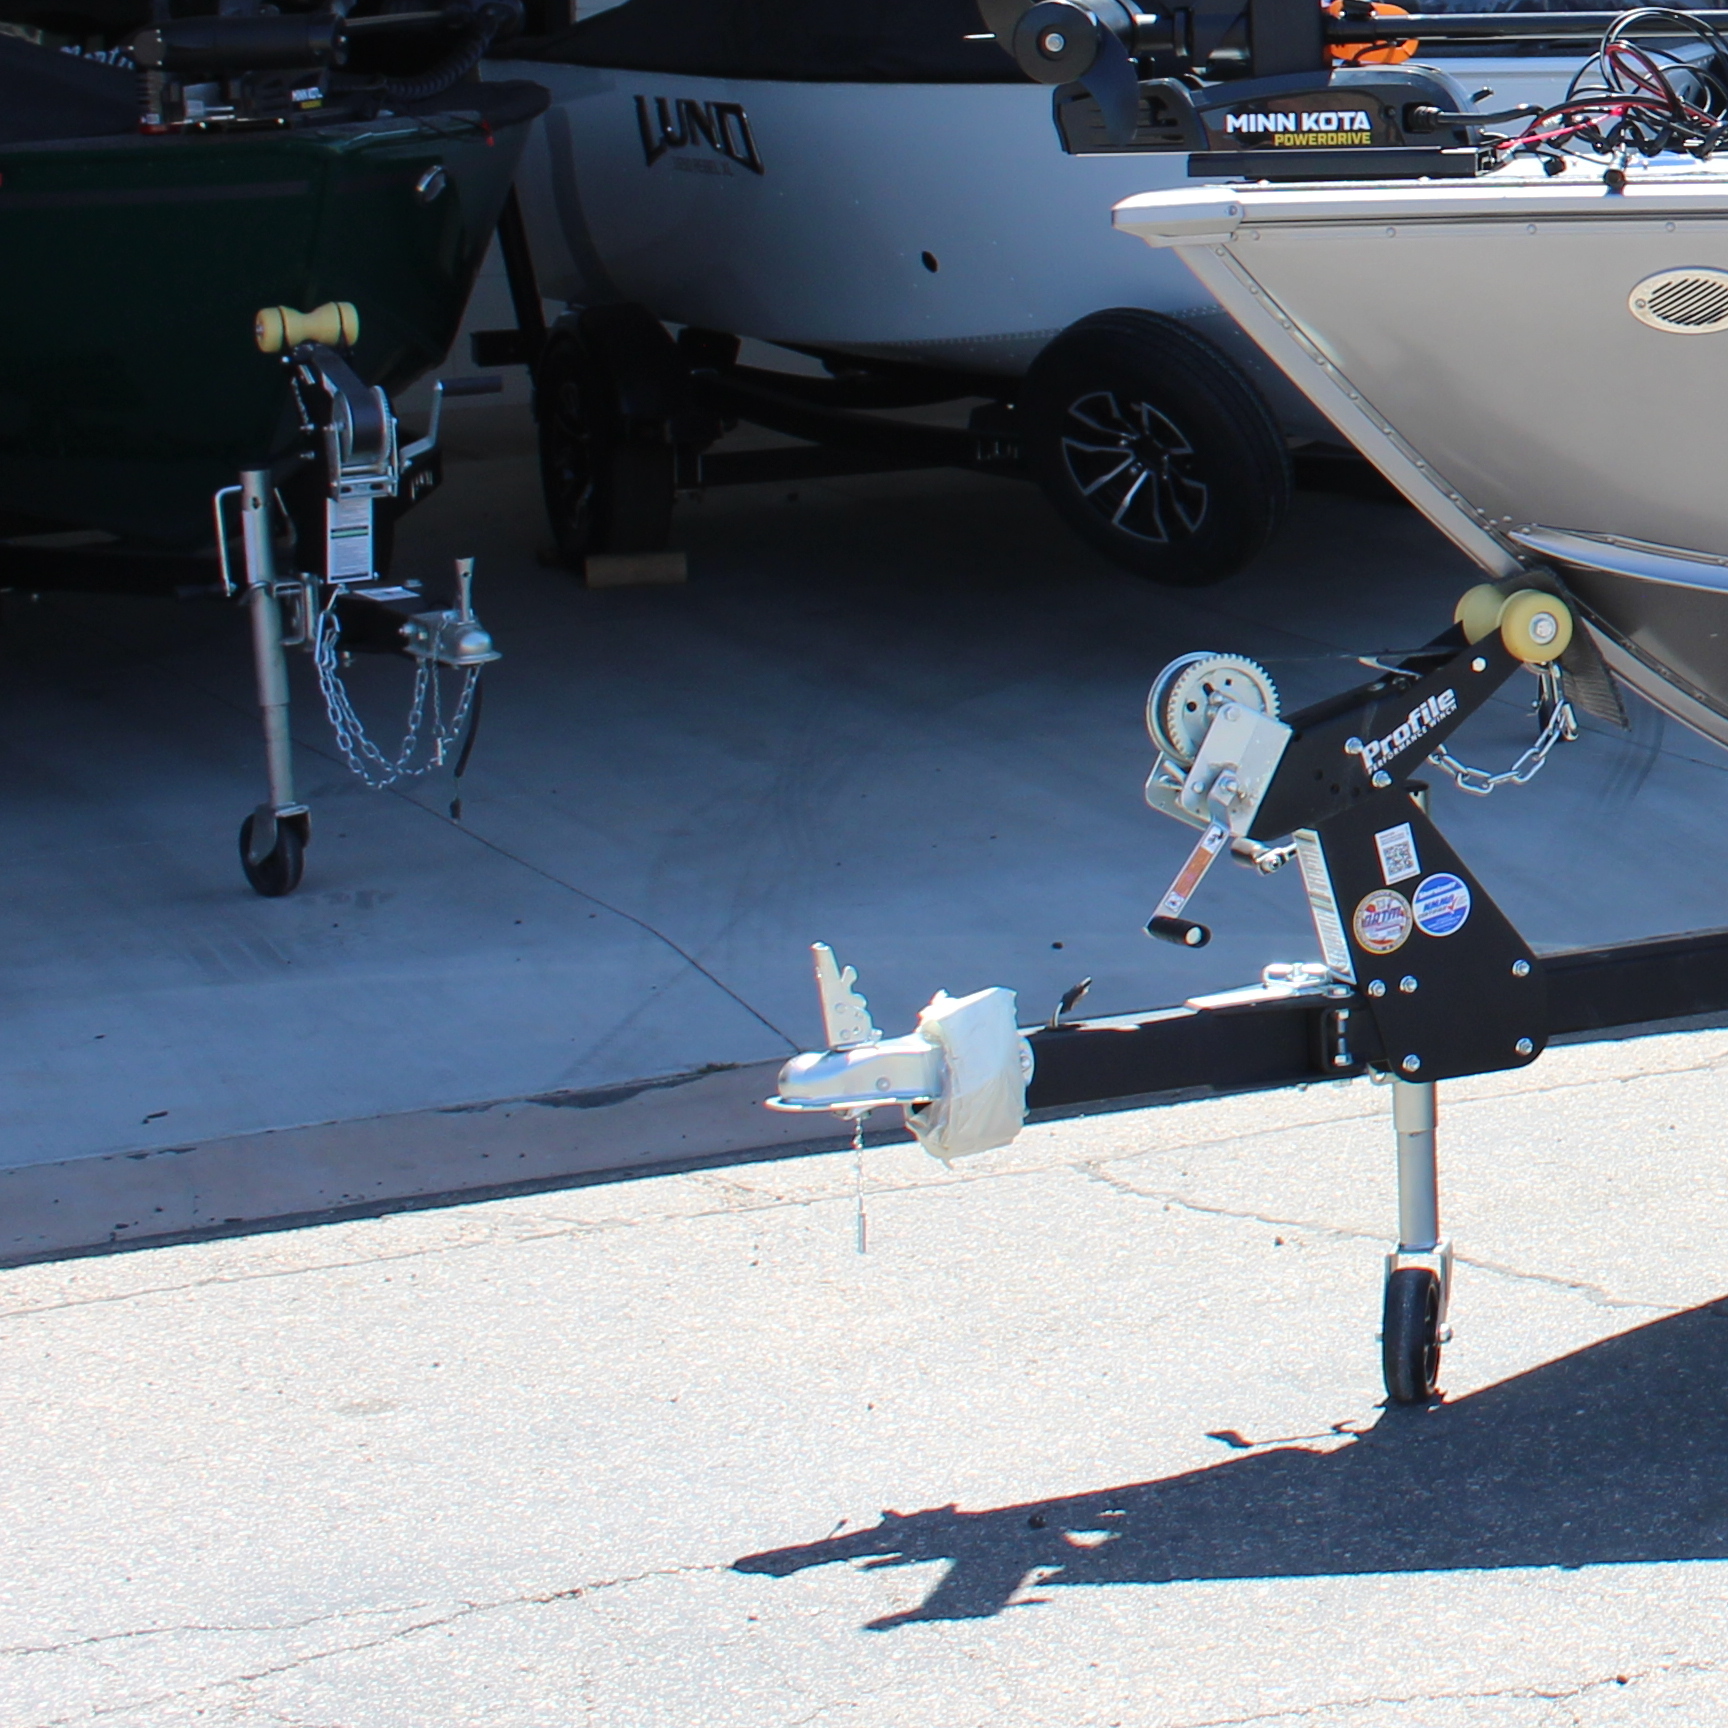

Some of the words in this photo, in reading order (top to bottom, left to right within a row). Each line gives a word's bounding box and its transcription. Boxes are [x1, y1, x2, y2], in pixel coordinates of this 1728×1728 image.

[634, 95, 766, 176] LUND
[1226, 112, 1296, 133] MINN
[1301, 111, 1372, 132] KOTA
[1274, 132, 1372, 146] POWERDRIVE
[1361, 688, 1456, 771] Profile
